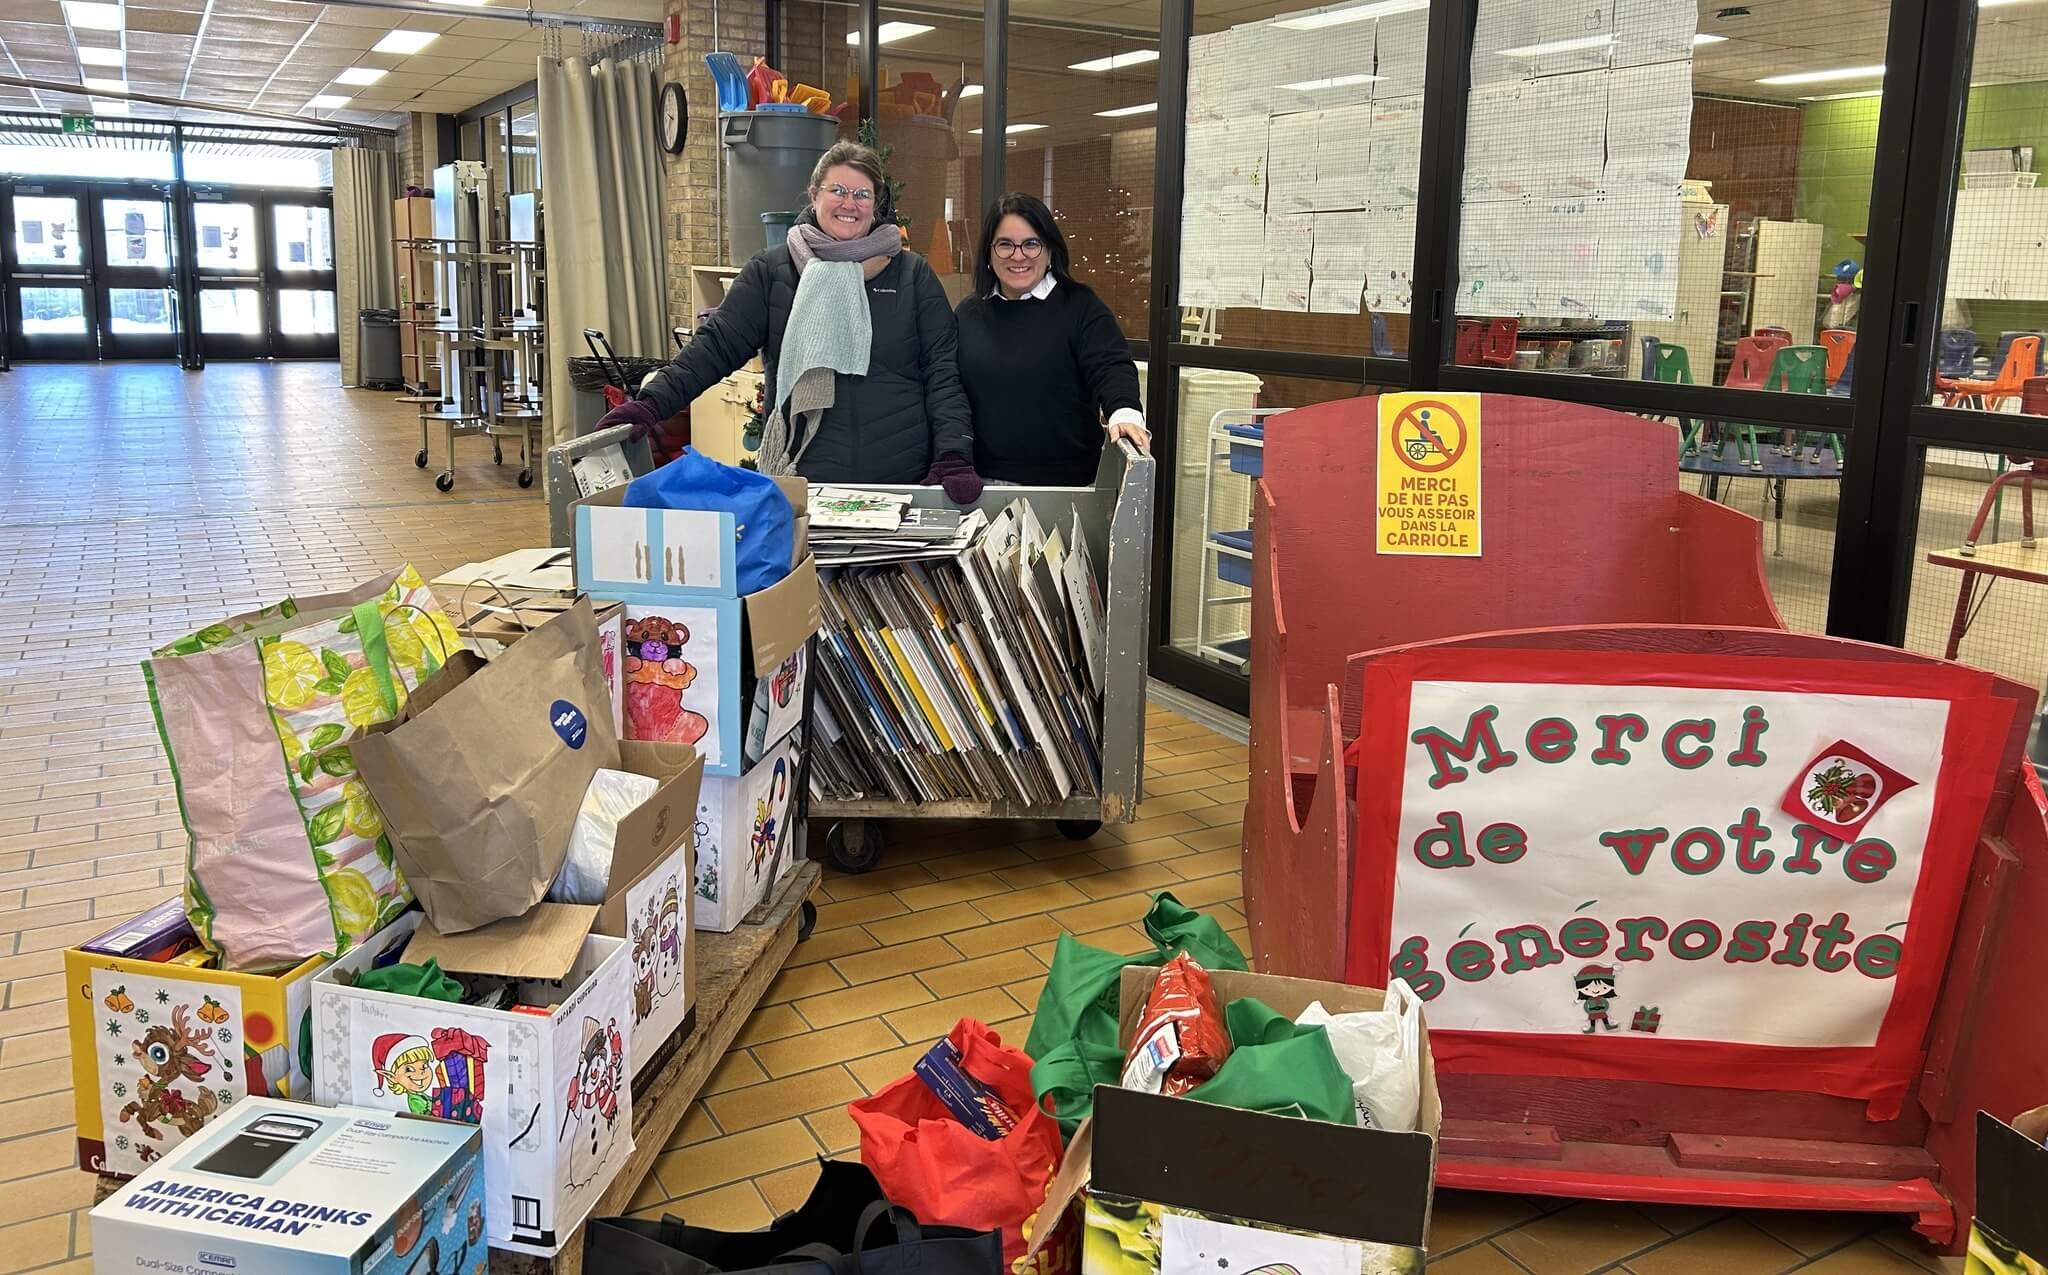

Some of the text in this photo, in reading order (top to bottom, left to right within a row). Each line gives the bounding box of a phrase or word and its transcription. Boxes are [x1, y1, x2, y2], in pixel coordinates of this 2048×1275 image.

[1401, 477, 1456, 492] MERCI
[1387, 492, 1469, 507] DE NE PAS
[1379, 507, 1476, 520] VOUS ASSEOIR
[1400, 520, 1457, 532] DANS LA
[1386, 532, 1469, 547] CARRIOLE
[1411, 704, 1770, 790] Merci
[1413, 810, 1528, 870] de
[1600, 806, 1898, 884] votre
[1391, 900, 1909, 1001] générosité
[124, 1194, 202, 1220] WITH
[140, 1180, 373, 1227] AMERICA DRINKS
[135, 1256, 184, 1273] Dual-Size
